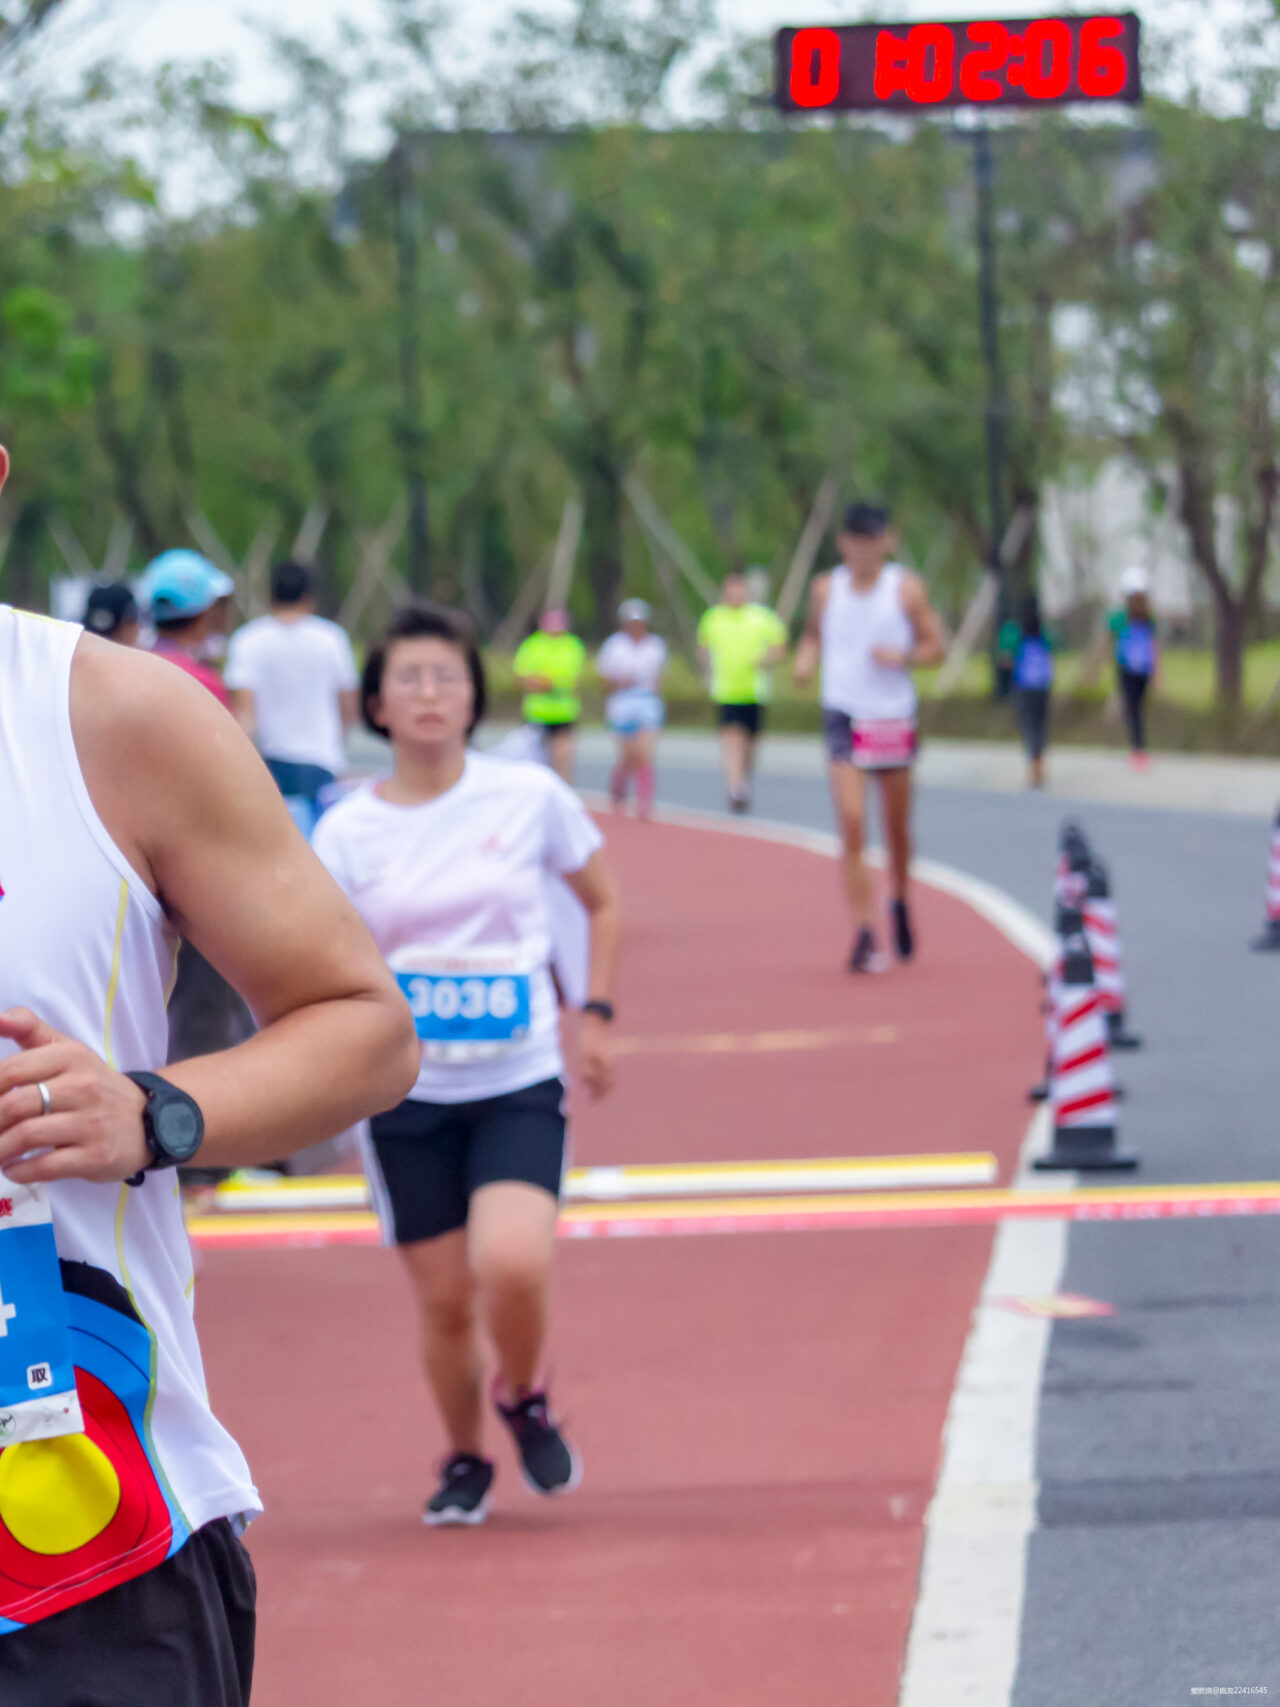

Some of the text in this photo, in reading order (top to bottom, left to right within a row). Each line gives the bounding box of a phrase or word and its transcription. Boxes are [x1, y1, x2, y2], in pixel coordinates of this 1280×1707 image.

[790, 17, 1126, 106] 0 1:02:06
[408, 977, 518, 1019] 3036
[31, 1367, 48, 1384] 取
